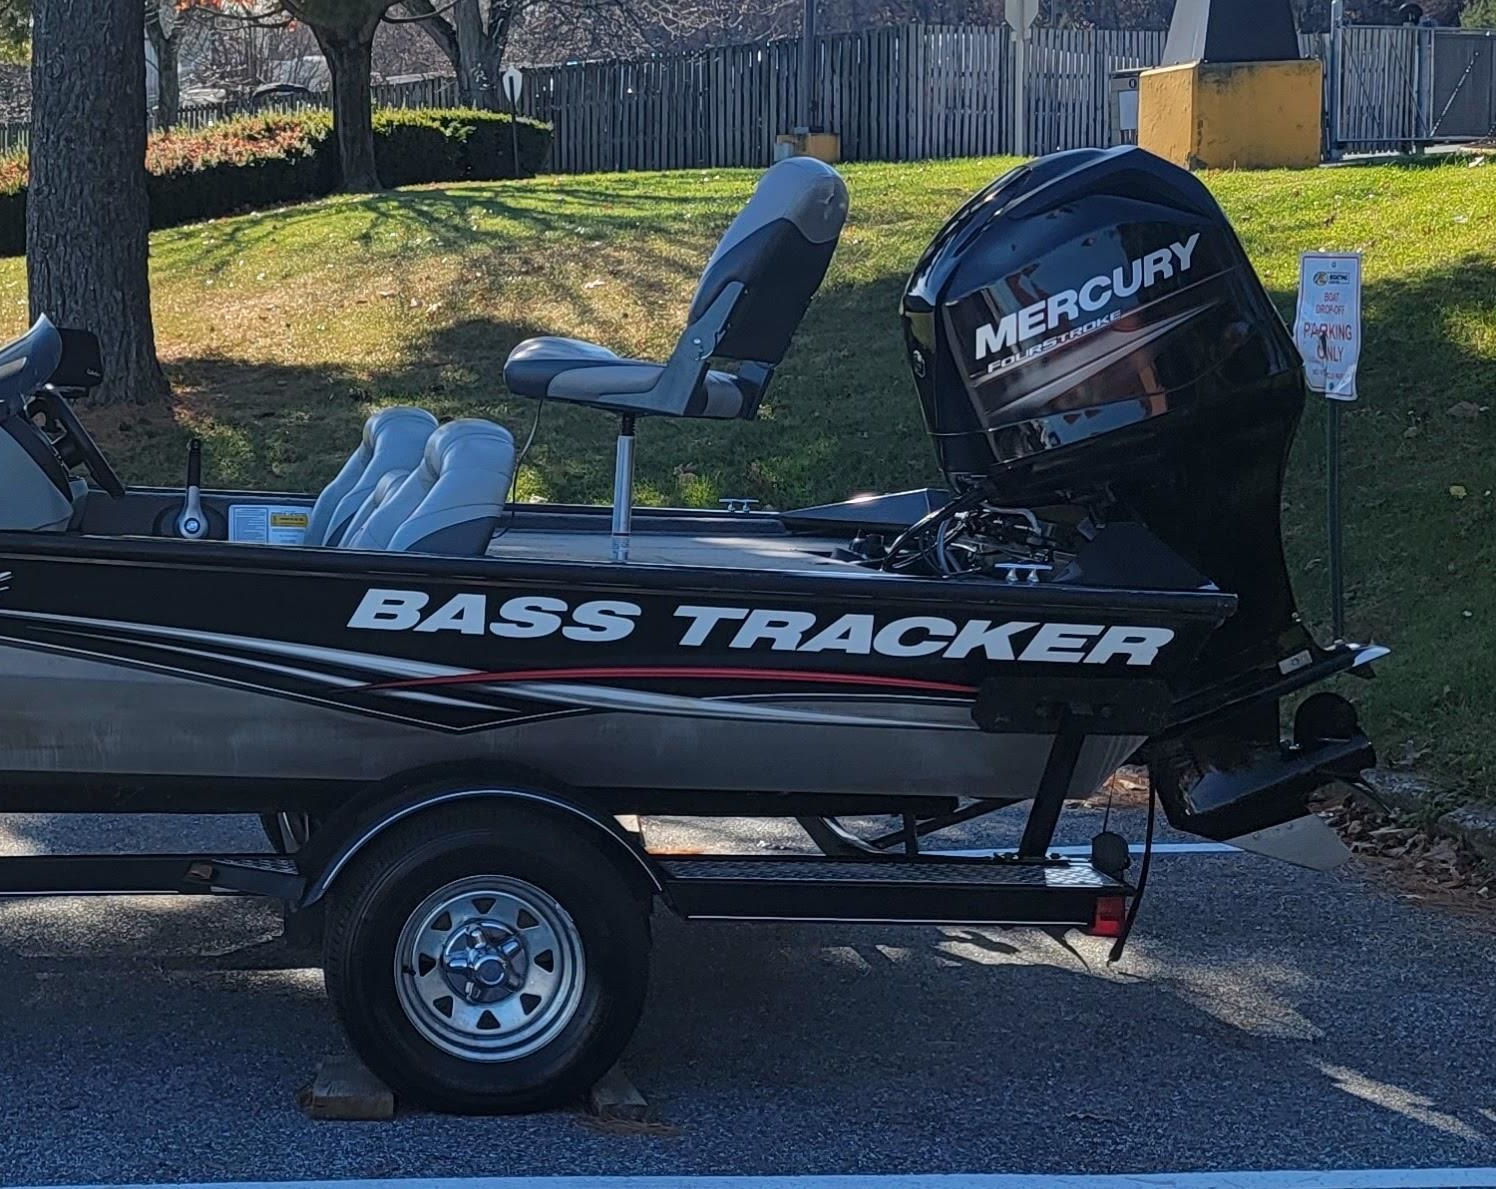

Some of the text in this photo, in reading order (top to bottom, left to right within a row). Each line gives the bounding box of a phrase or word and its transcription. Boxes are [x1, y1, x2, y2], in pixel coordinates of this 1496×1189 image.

[975, 232, 1201, 360] MERCURY
[1304, 322, 1352, 341] PARKING
[987, 309, 1122, 374] FOURSTROKE
[346, 587, 1175, 666] BASS TRACKER
